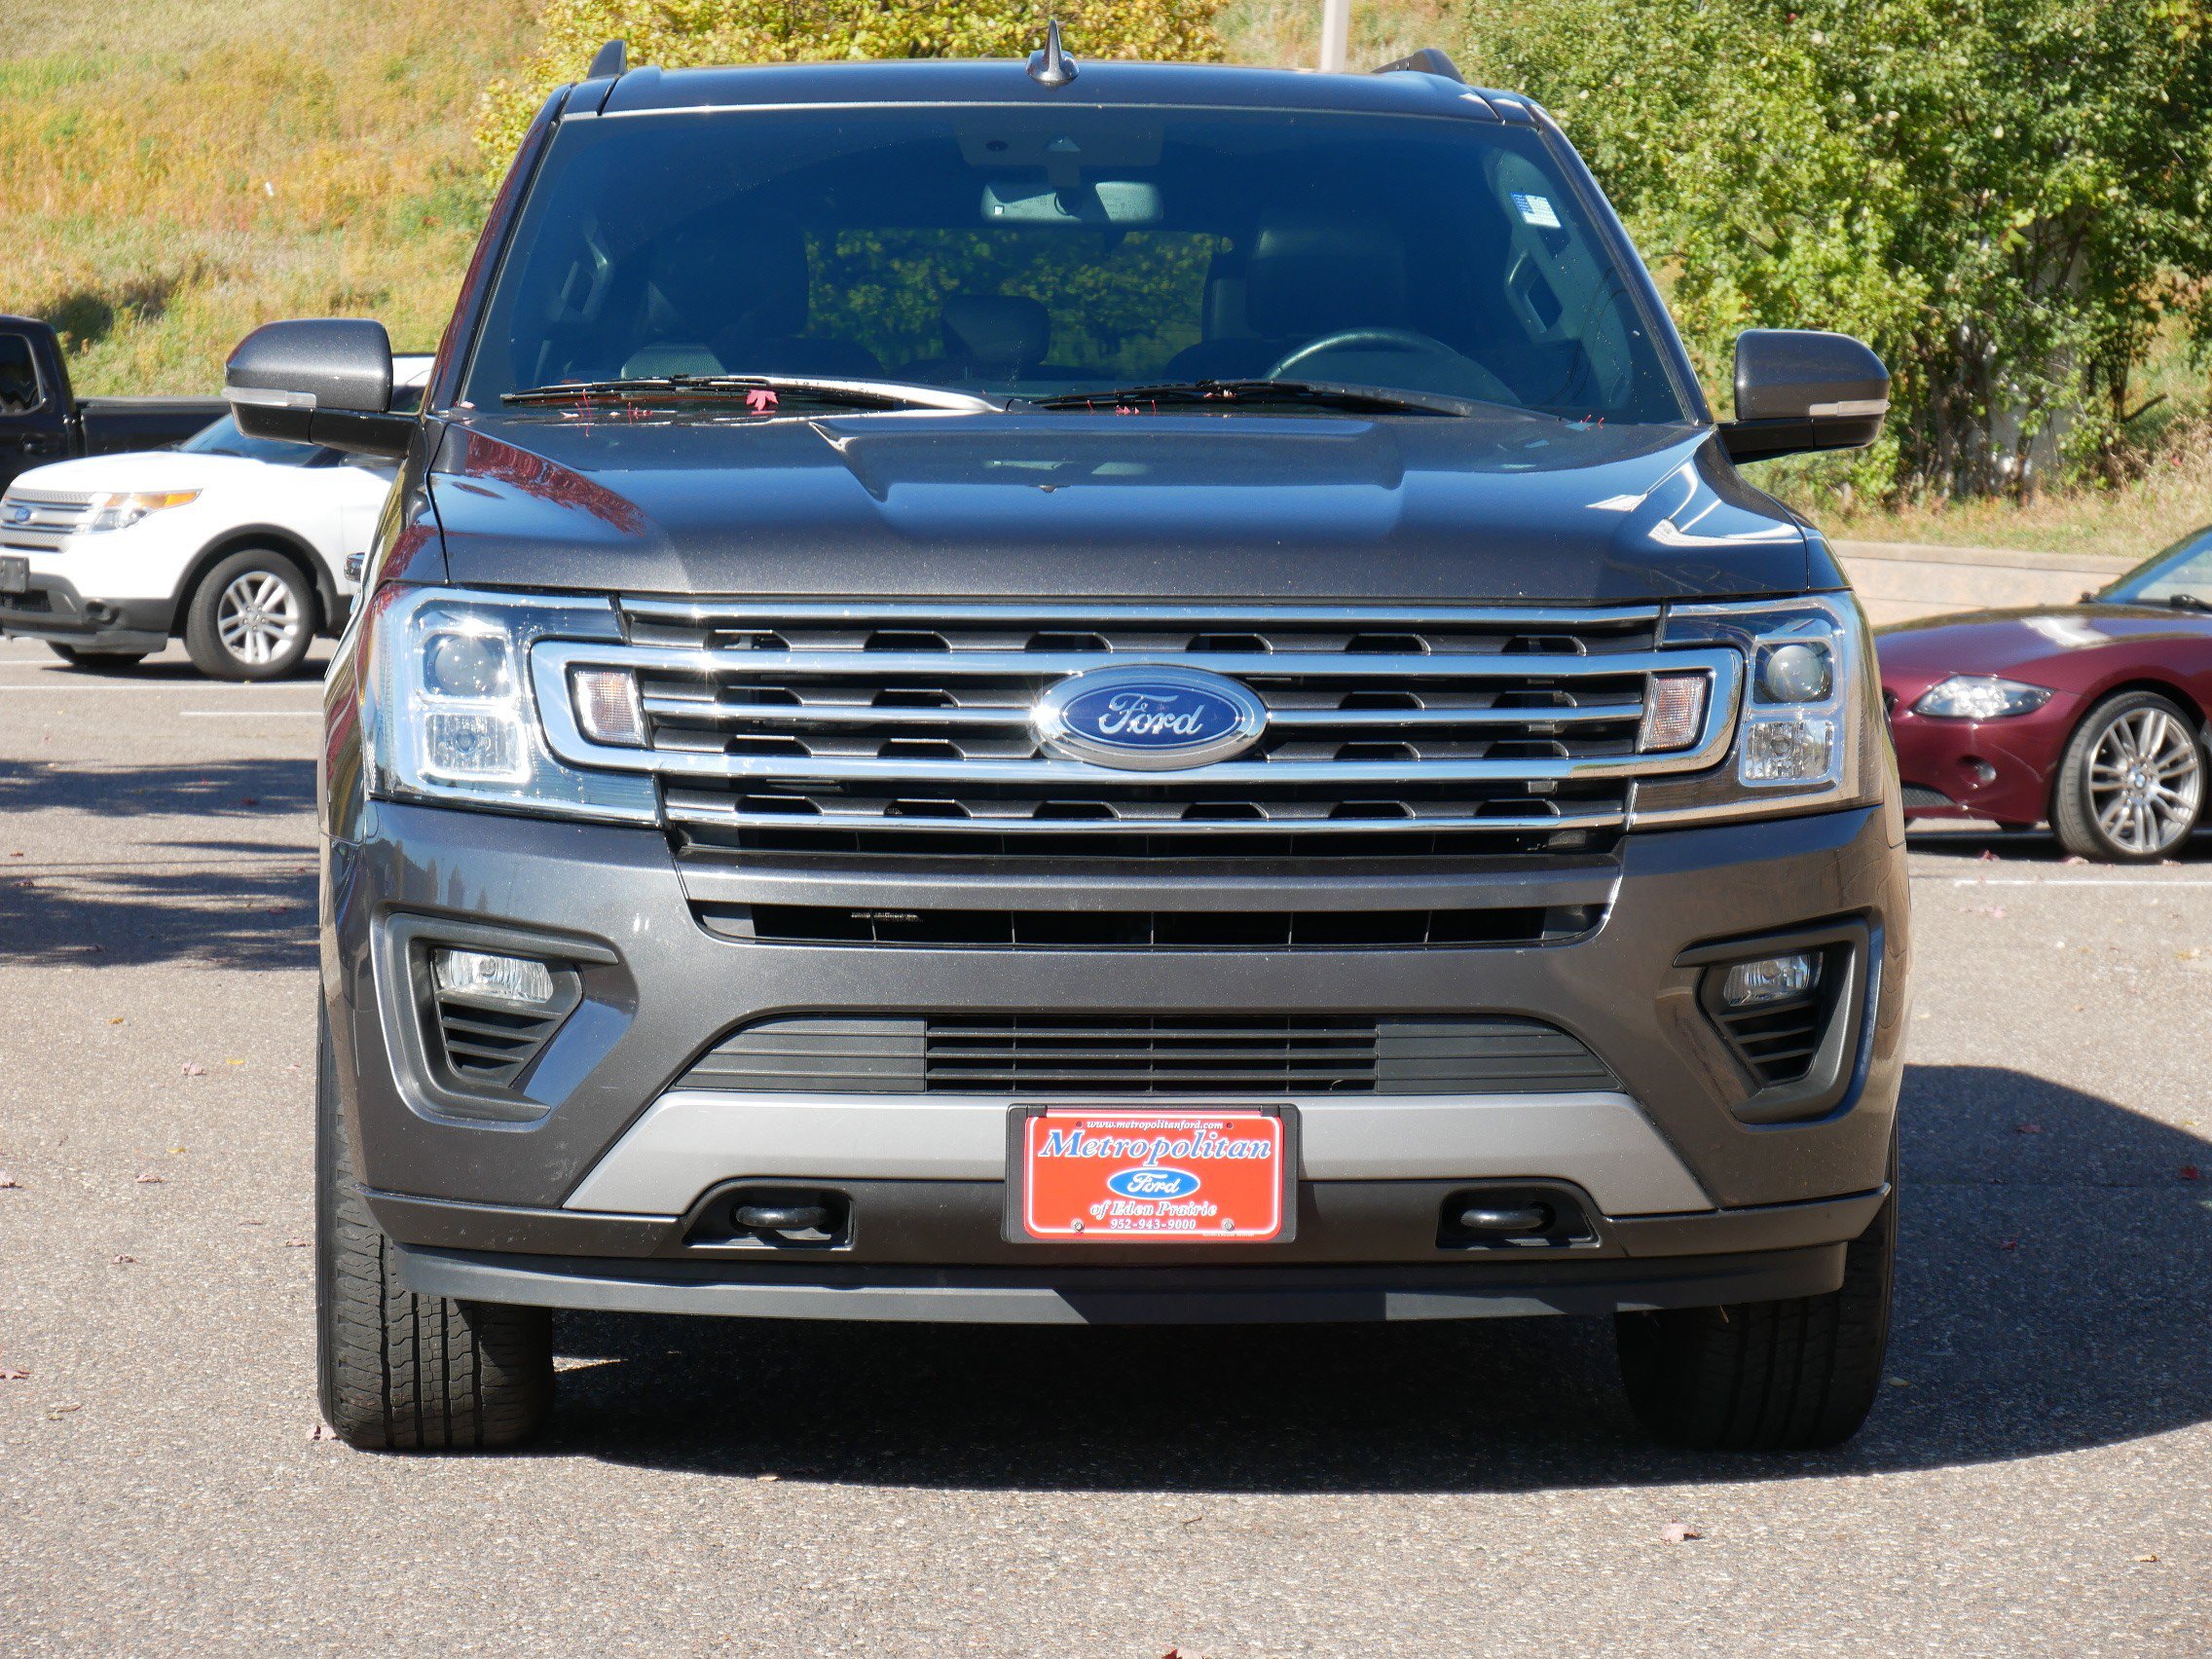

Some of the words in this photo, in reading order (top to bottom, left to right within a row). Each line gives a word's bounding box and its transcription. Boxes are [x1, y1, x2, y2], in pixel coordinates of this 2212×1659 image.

[1098, 692, 1205, 736] Ford
[1087, 1120, 1224, 1132] www.metropolitanford.com
[1038, 1128, 1272, 1167] Metropolitan
[1126, 1172, 1181, 1194] Ford
[1089, 1198, 1110, 1220] of
[1110, 1200, 1154, 1216] Eden
[1156, 1200, 1218, 1216] Prairie
[1110, 1219, 1197, 1230] 952-943-9000
